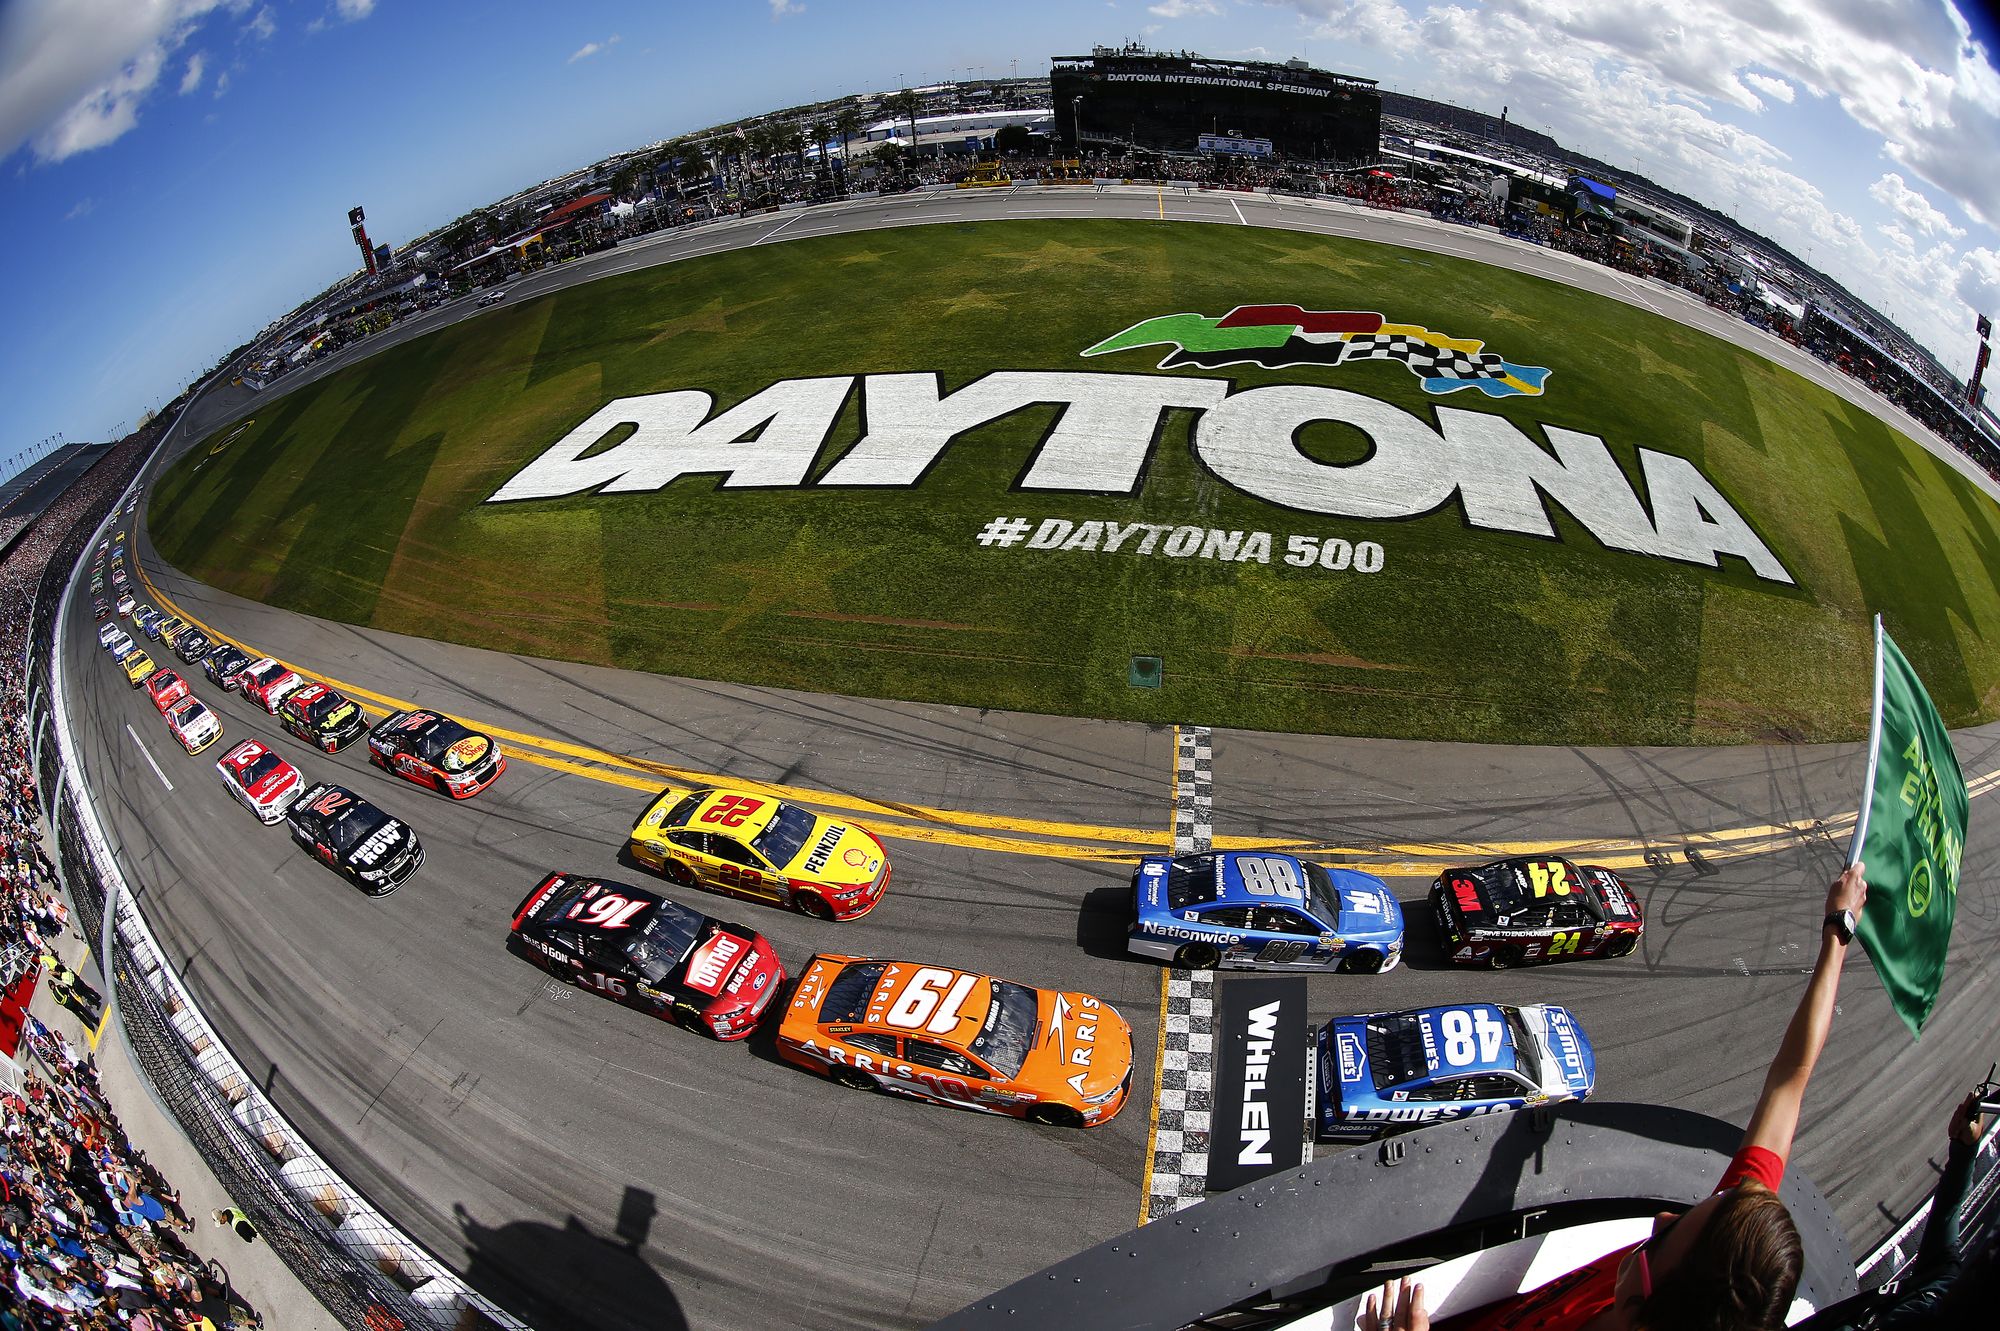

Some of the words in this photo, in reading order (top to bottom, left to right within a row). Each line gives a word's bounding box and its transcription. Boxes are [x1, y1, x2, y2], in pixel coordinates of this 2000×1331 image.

[1107, 74, 1161, 82] DAYTONA
[1165, 75, 1263, 89] INTERNATIONAL
[1266, 82, 1331, 98] SPEEDWAY
[485, 371, 1796, 585] DAYTONA
[976, 516, 1272, 564] #DAYTONA
[1283, 535, 1385, 574] 500
[465, 742, 487, 760] Shops
[256, 770, 296, 802] Motorcraft
[700, 794, 766, 828] 22
[348, 819, 401, 865] FURNITURE
[362, 829, 401, 865] ROW
[673, 850, 704, 864] Shell
[804, 825, 847, 874] PENNZOIL
[550, 879, 565, 894] BUG
[719, 863, 763, 895] 22
[1216, 855, 1226, 897] Nationwide
[1236, 857, 1303, 900] 88
[1527, 862, 1571, 898] 24
[527, 900, 545, 918] GON
[577, 894, 650, 930] 16
[1452, 879, 1482, 912] 3M
[1143, 920, 1241, 944] Nationwide
[1547, 932, 1581, 955] 24
[548, 948, 569, 964] GON
[691, 938, 740, 988] ORTHO
[742, 950, 760, 970] GON
[1255, 939, 1309, 963] 88
[592, 972, 627, 997] 16
[726, 973, 745, 995] BUG
[737, 966, 750, 977] B
[794, 964, 823, 1008] ARRIS
[868, 965, 900, 1023] ARRIS
[886, 967, 979, 1035] 19
[984, 1000, 1000, 1032] EDWARDS
[1066, 996, 1101, 1097] ARRIS
[1418, 1013, 1440, 1072] LOWE'S
[1441, 1008, 1503, 1066] 48
[1550, 1012, 1585, 1080] LOWE'S
[801, 1039, 913, 1079] ARRIS
[1341, 1039, 1355, 1076] LOWE'S
[919, 1072, 976, 1104] 19
[1238, 1000, 1280, 1165] WHELEN
[1344, 1103, 1462, 1122] LOWE'S
